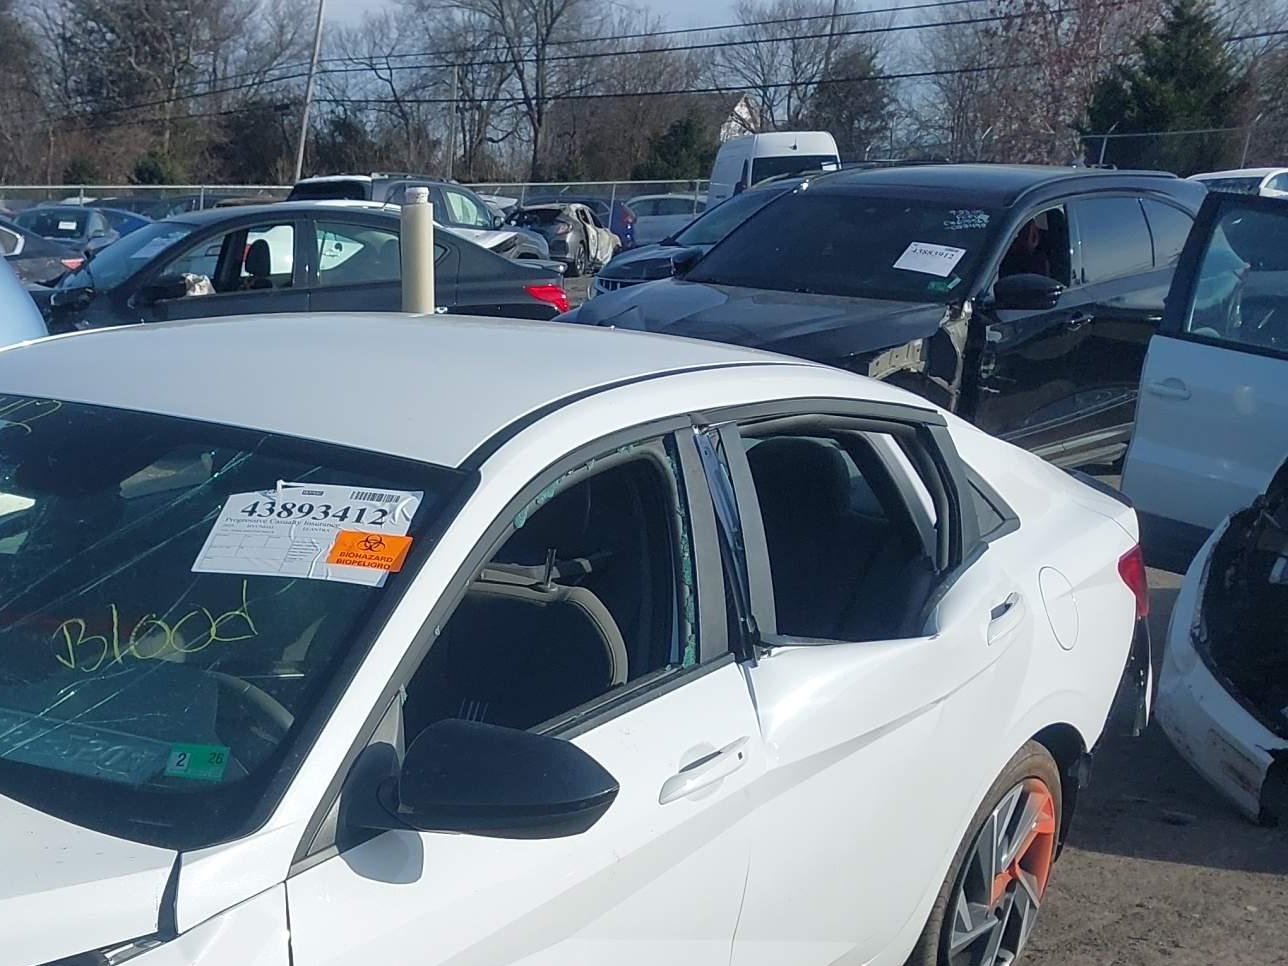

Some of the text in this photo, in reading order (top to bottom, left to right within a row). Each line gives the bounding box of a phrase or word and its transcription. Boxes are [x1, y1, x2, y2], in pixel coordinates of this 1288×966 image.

[240, 500, 388, 526] 43893412
[224, 517, 341, 528] Progressive Casualty Insurance
[335, 557, 391, 570] BIOPELIGRO
[338, 551, 394, 563] BIOHAZARD
[50, 579, 258, 672] Blood
[175, 751, 225, 767] 2 26
